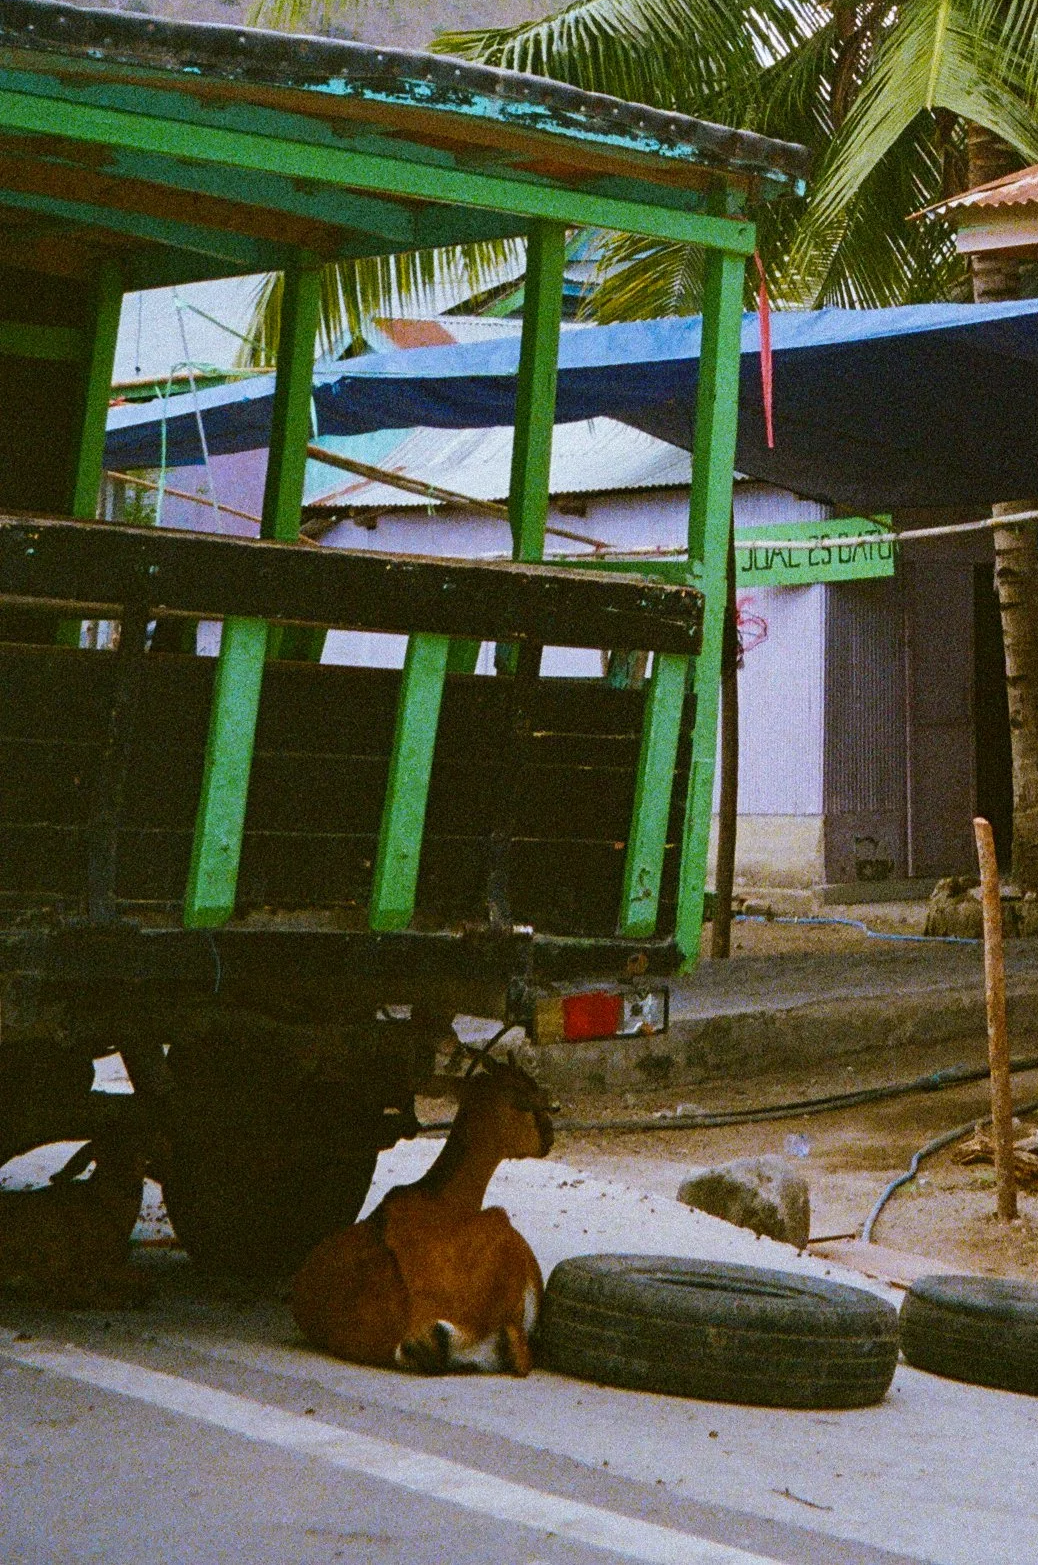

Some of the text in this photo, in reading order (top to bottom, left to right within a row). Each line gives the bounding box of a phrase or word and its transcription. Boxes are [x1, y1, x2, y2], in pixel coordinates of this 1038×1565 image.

[741, 529, 892, 572] JUAL ES BATU
